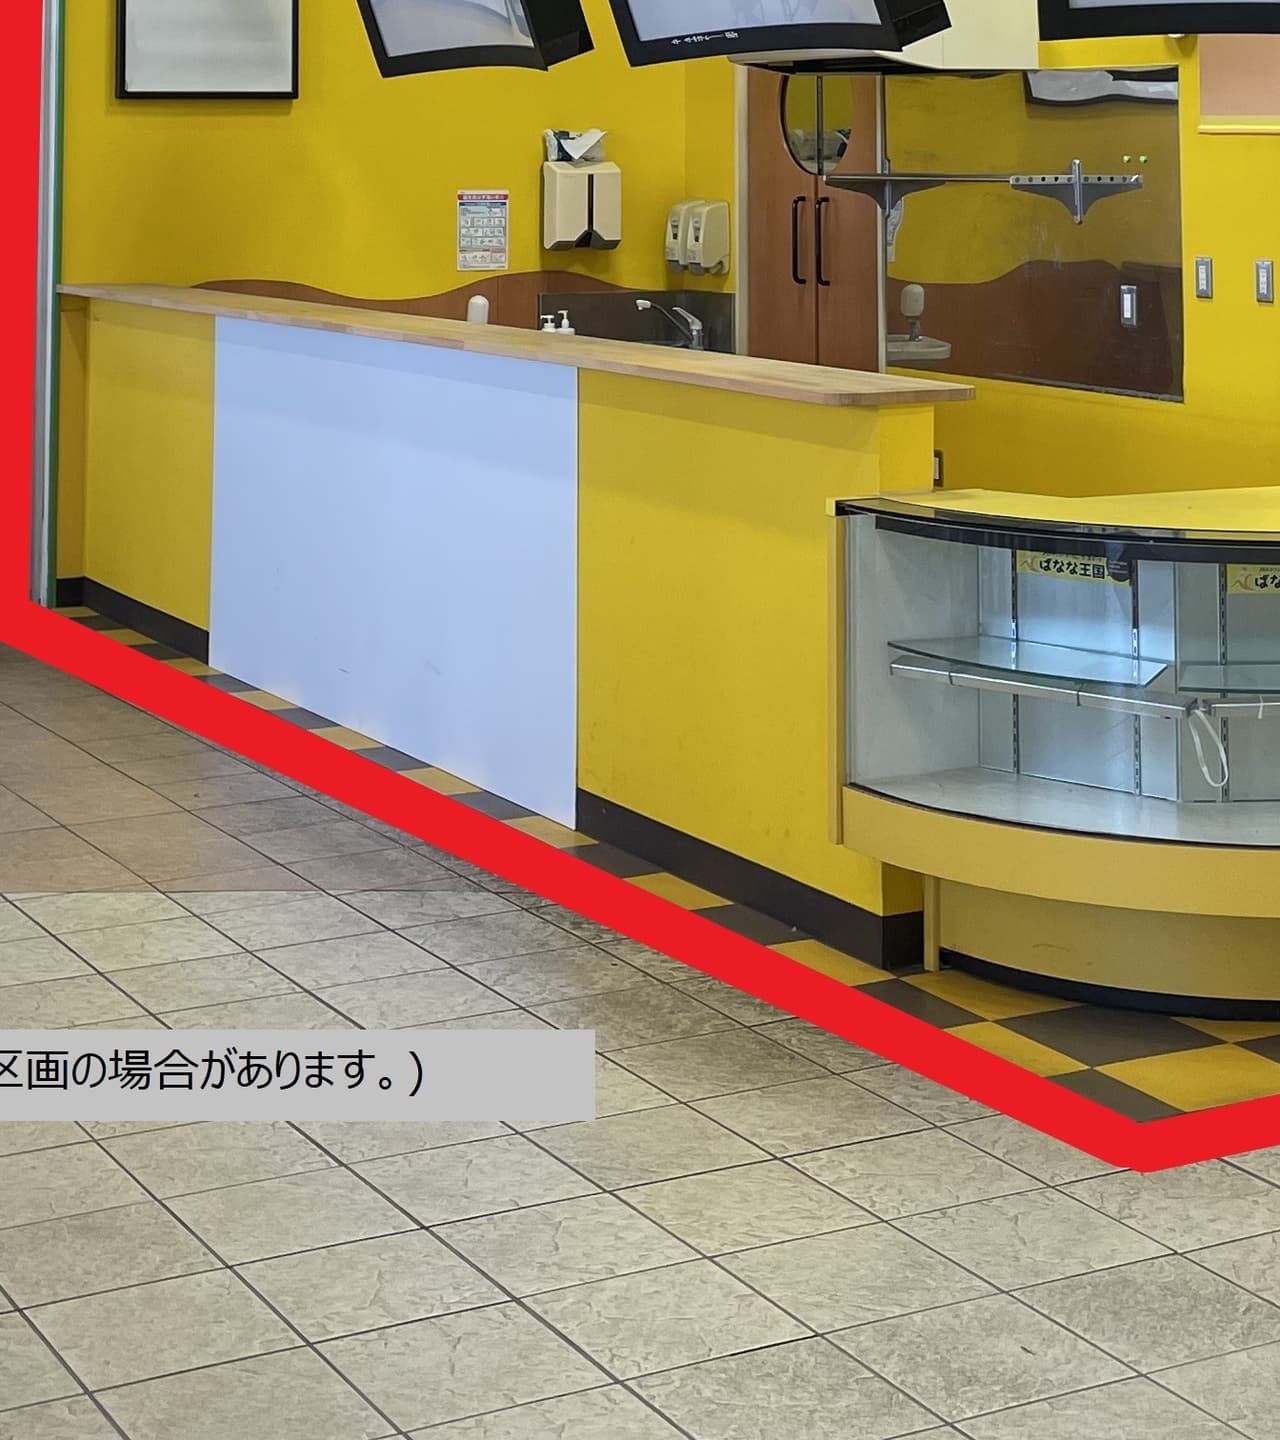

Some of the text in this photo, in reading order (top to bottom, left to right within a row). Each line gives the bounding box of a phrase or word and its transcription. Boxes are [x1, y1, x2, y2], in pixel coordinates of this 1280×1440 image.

[1040, 558, 1105, 579] ばなな王国
